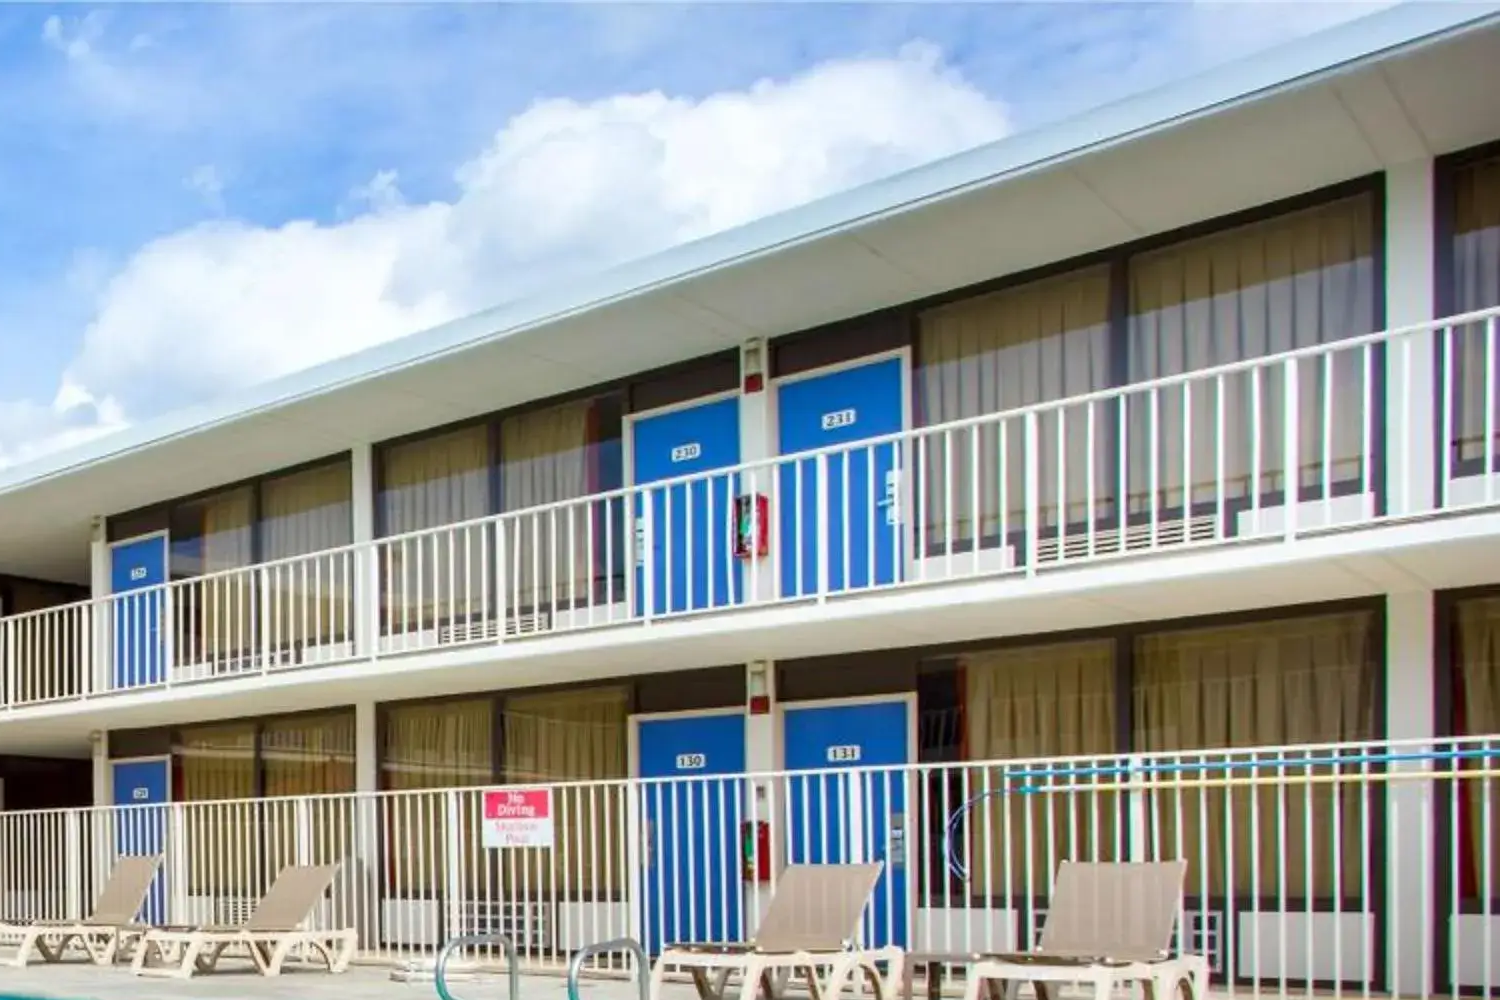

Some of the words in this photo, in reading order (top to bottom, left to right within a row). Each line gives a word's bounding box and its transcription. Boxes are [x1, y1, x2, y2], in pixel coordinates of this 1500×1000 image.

[826, 411, 851, 427] 231
[831, 747, 855, 759] 131
[679, 755, 702, 767] 130
